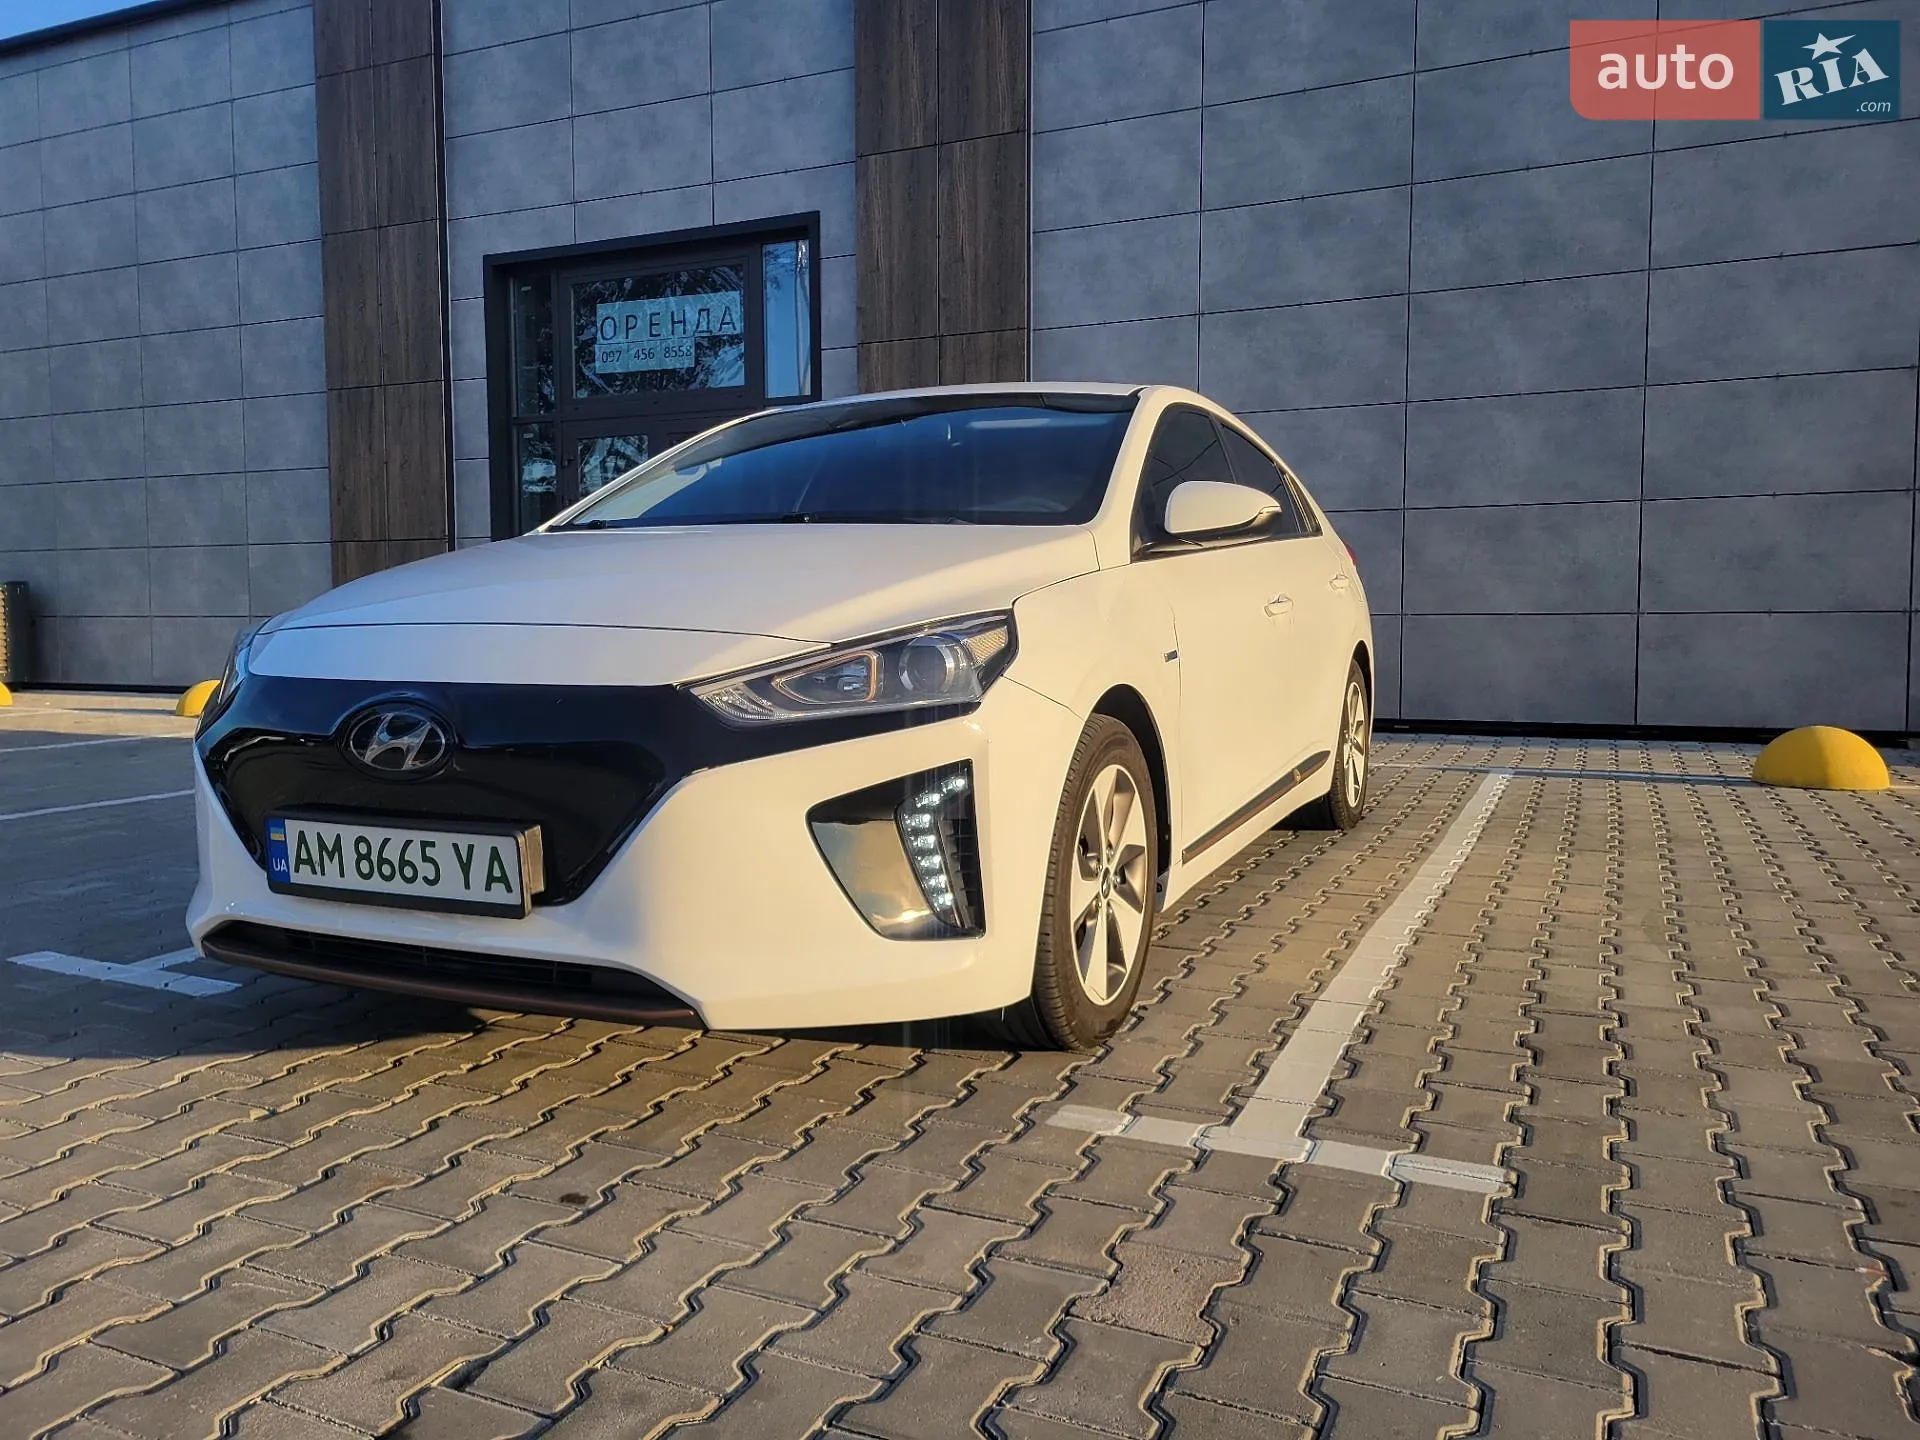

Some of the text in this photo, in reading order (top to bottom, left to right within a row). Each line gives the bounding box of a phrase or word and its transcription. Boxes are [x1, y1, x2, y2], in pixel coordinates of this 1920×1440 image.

[600, 305, 738, 341] ОРЕНДА
[633, 347, 655, 361] 456
[272, 858, 288, 873] UA
[293, 829, 514, 894] AM 8665 YA
